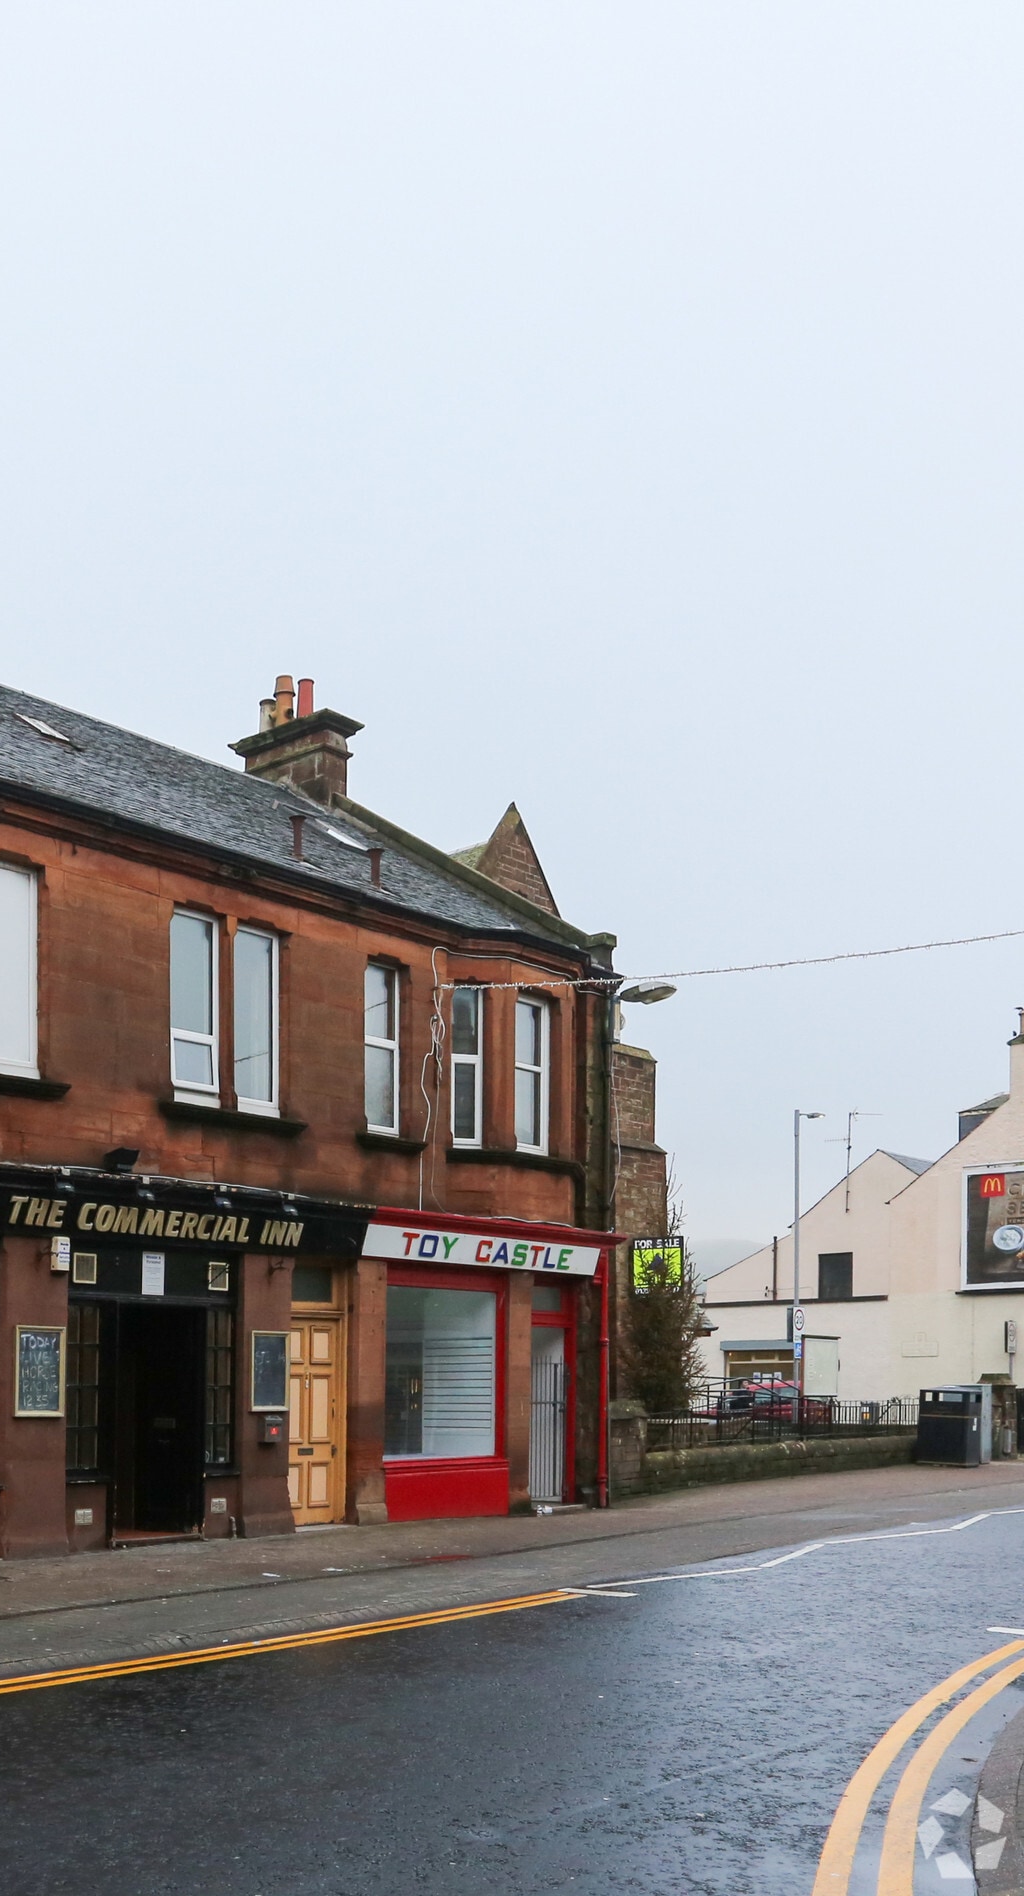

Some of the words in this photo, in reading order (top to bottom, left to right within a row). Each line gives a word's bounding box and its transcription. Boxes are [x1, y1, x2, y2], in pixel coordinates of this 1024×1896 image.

[1008, 1183, 1024, 1196] C
[7, 1195, 67, 1228] THE
[76, 1202, 250, 1244] COMMERCIAL
[259, 1219, 305, 1247] INN
[402, 1231, 459, 1260] TOY
[474, 1240, 574, 1271] CASTLE
[634, 1239, 653, 1249] FOR
[21, 1334, 57, 1349] TODAY
[21, 1365, 57, 1380] HORSE
